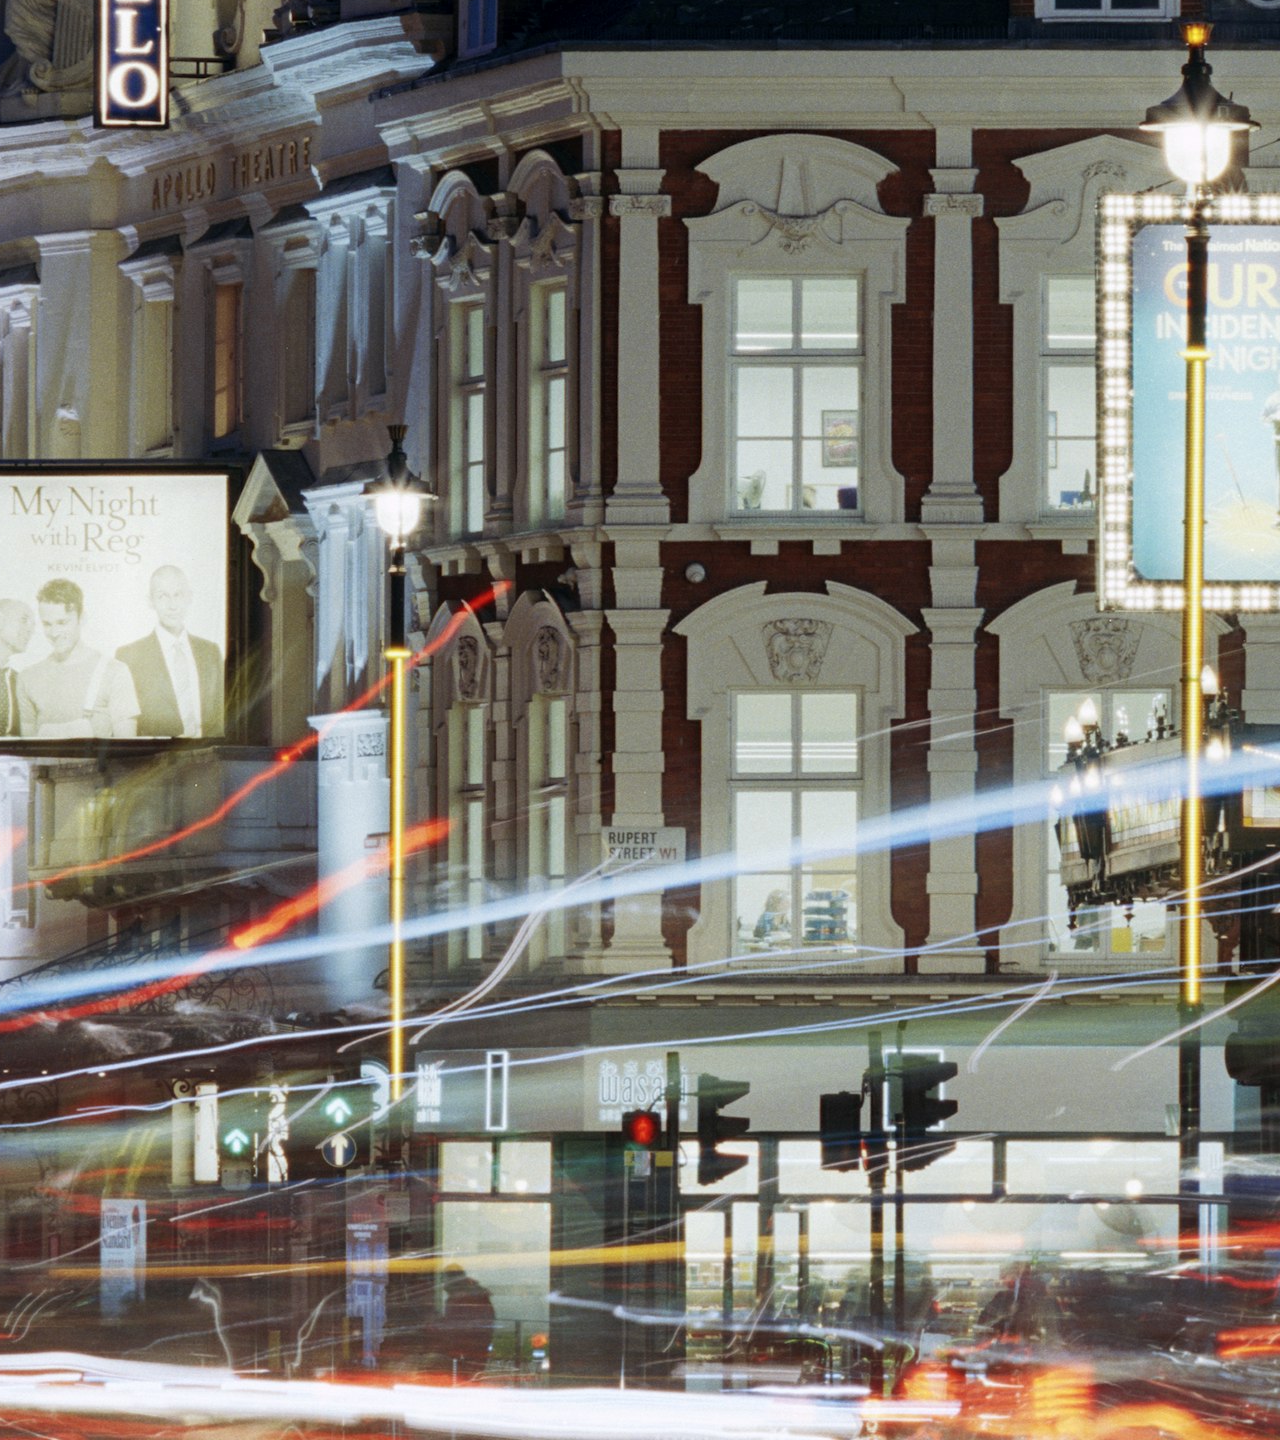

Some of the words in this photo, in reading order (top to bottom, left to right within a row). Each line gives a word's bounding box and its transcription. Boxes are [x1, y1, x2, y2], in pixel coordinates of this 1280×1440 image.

[151, 163, 216, 210] APOLLO
[231, 136, 313, 189] THEATRE
[1162, 240, 1184, 252] The
[10, 485, 62, 528] My
[67, 485, 160, 532] Night
[30, 525, 78, 547] with
[82, 522, 145, 565] Reg
[47, 563, 83, 573] KEVIN
[608, 831, 657, 844] RUPERT
[659, 847, 677, 860] W1
[600, 1066, 688, 1103] wasai
